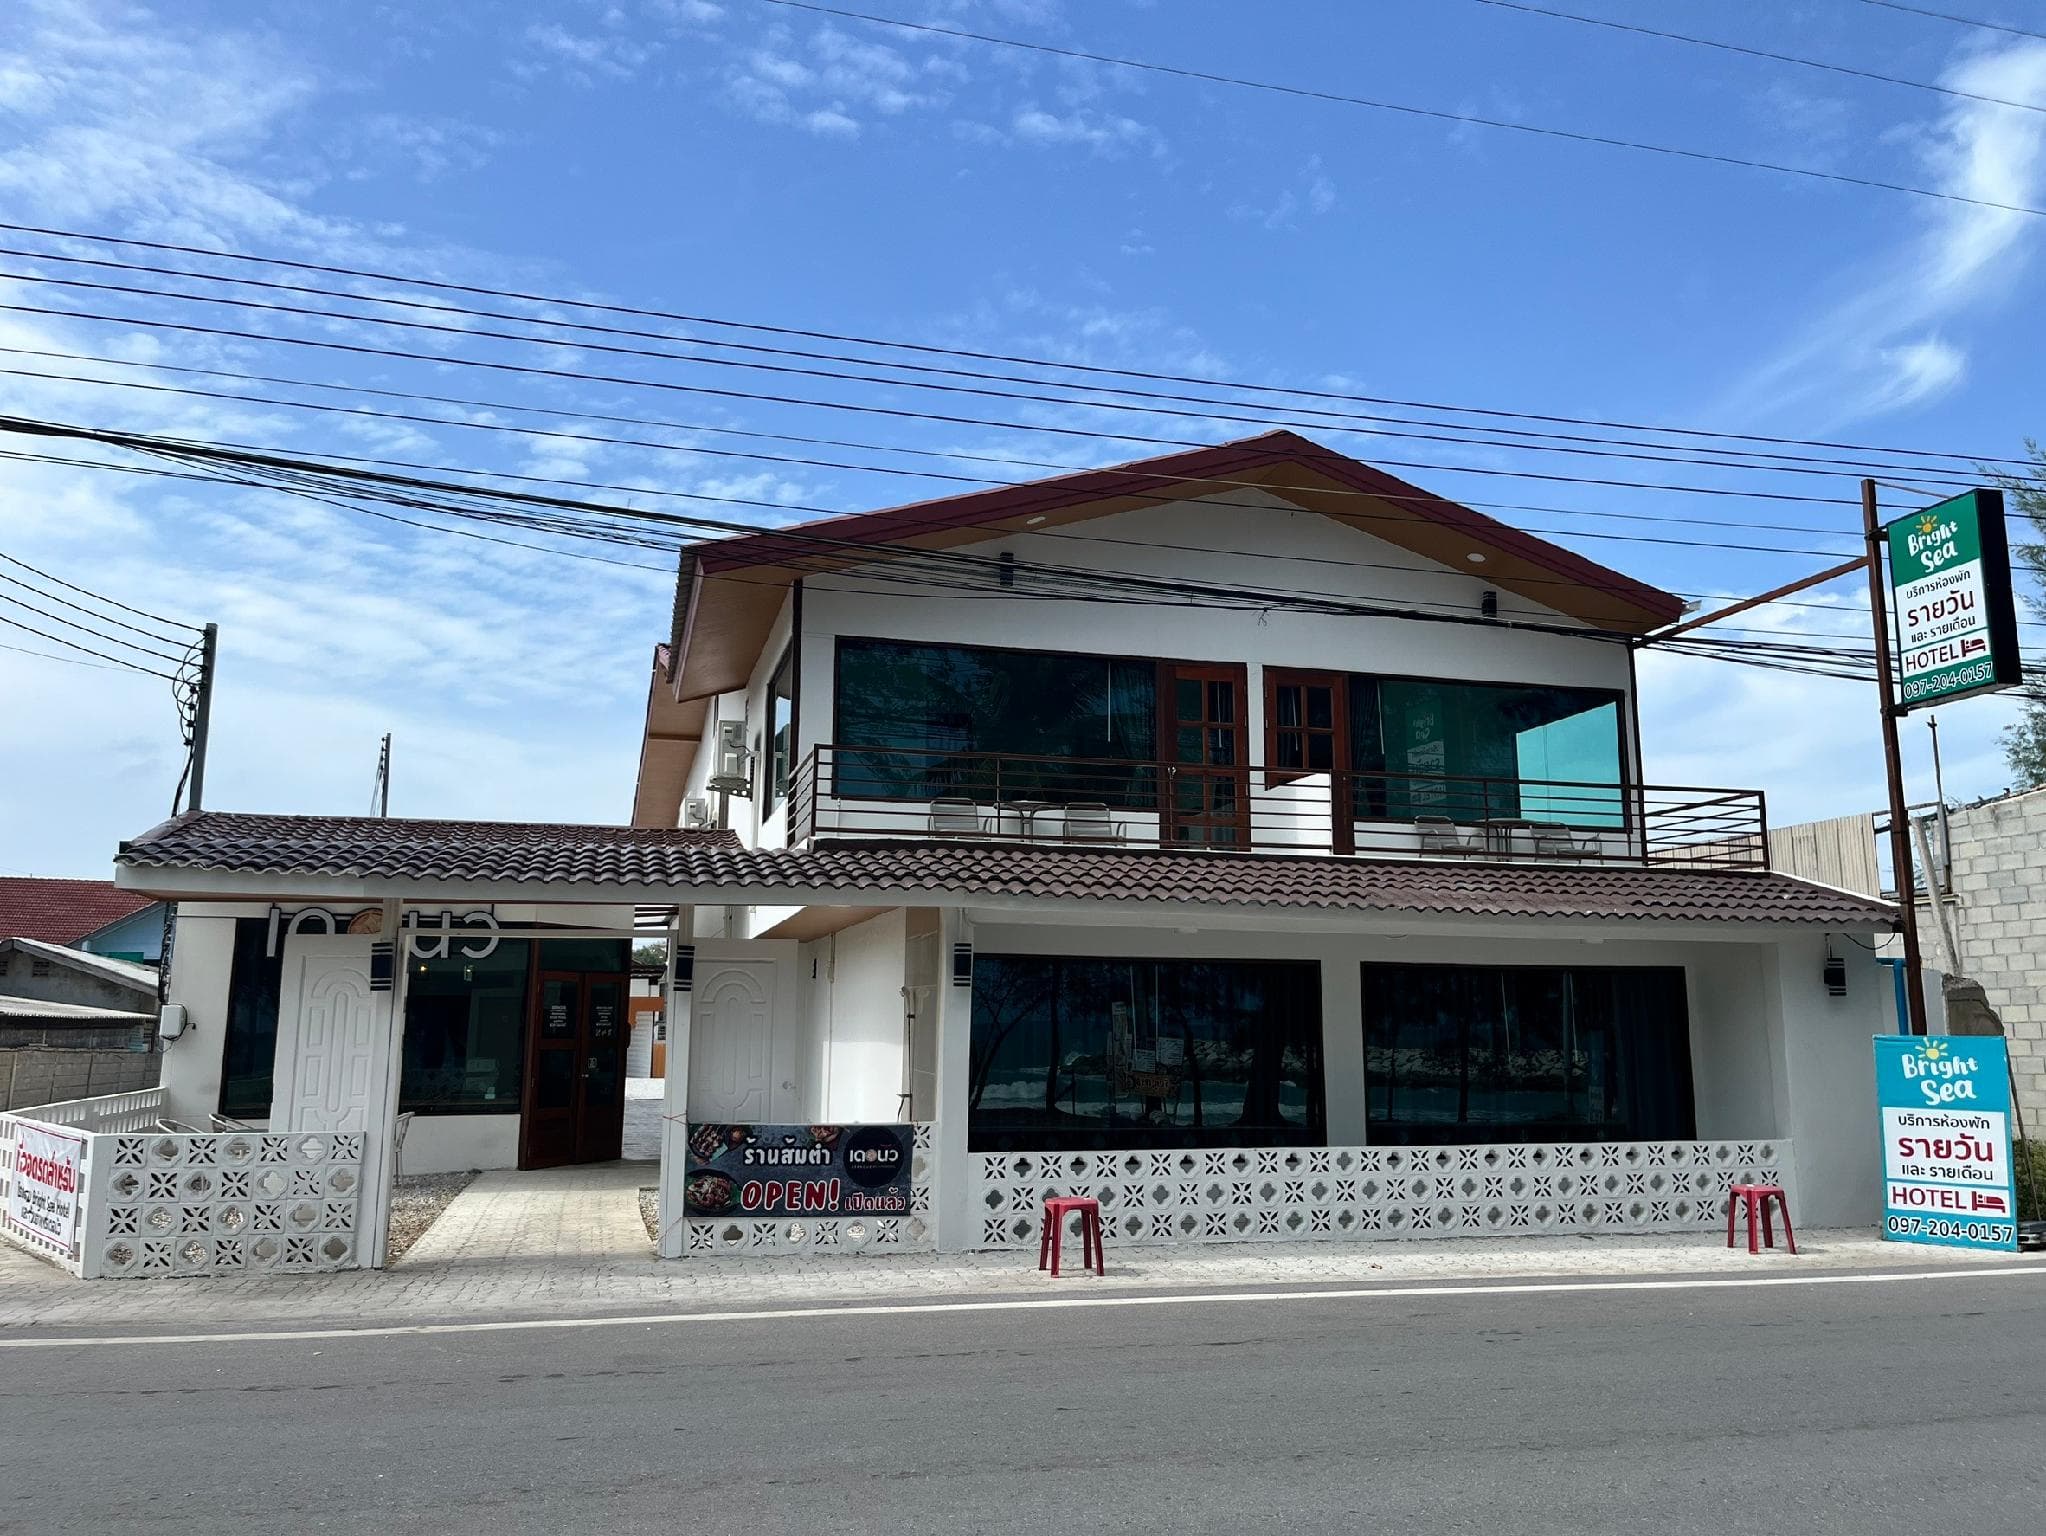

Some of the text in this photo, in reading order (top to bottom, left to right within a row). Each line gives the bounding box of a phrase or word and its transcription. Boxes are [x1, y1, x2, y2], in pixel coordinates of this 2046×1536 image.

[1907, 520, 1958, 557] Bright
[1920, 541, 1958, 574] Sea
[1906, 569, 1971, 600] บริการห้องพัก
[1907, 590, 1975, 627] รายวัน
[1906, 643, 1960, 672] HOTEL
[1904, 661, 1993, 699] 097-204-0157
[1901, 1054, 1978, 1079] Bright
[1920, 1079, 1977, 1106] Sea
[1898, 1113, 1991, 1130] บริการห้องพัก
[743, 1137, 832, 1166] ร้านส้มตำ
[1898, 1132, 1993, 1162] รายวัน
[1902, 1163, 1993, 1181] และ รายเดือน
[741, 1178, 841, 1212] OPEN!
[844, 1187, 906, 1211] เปิดแล้ว
[1892, 1186, 1967, 1210] HOTEL
[1888, 1215, 2014, 1243] 097-204-0157
